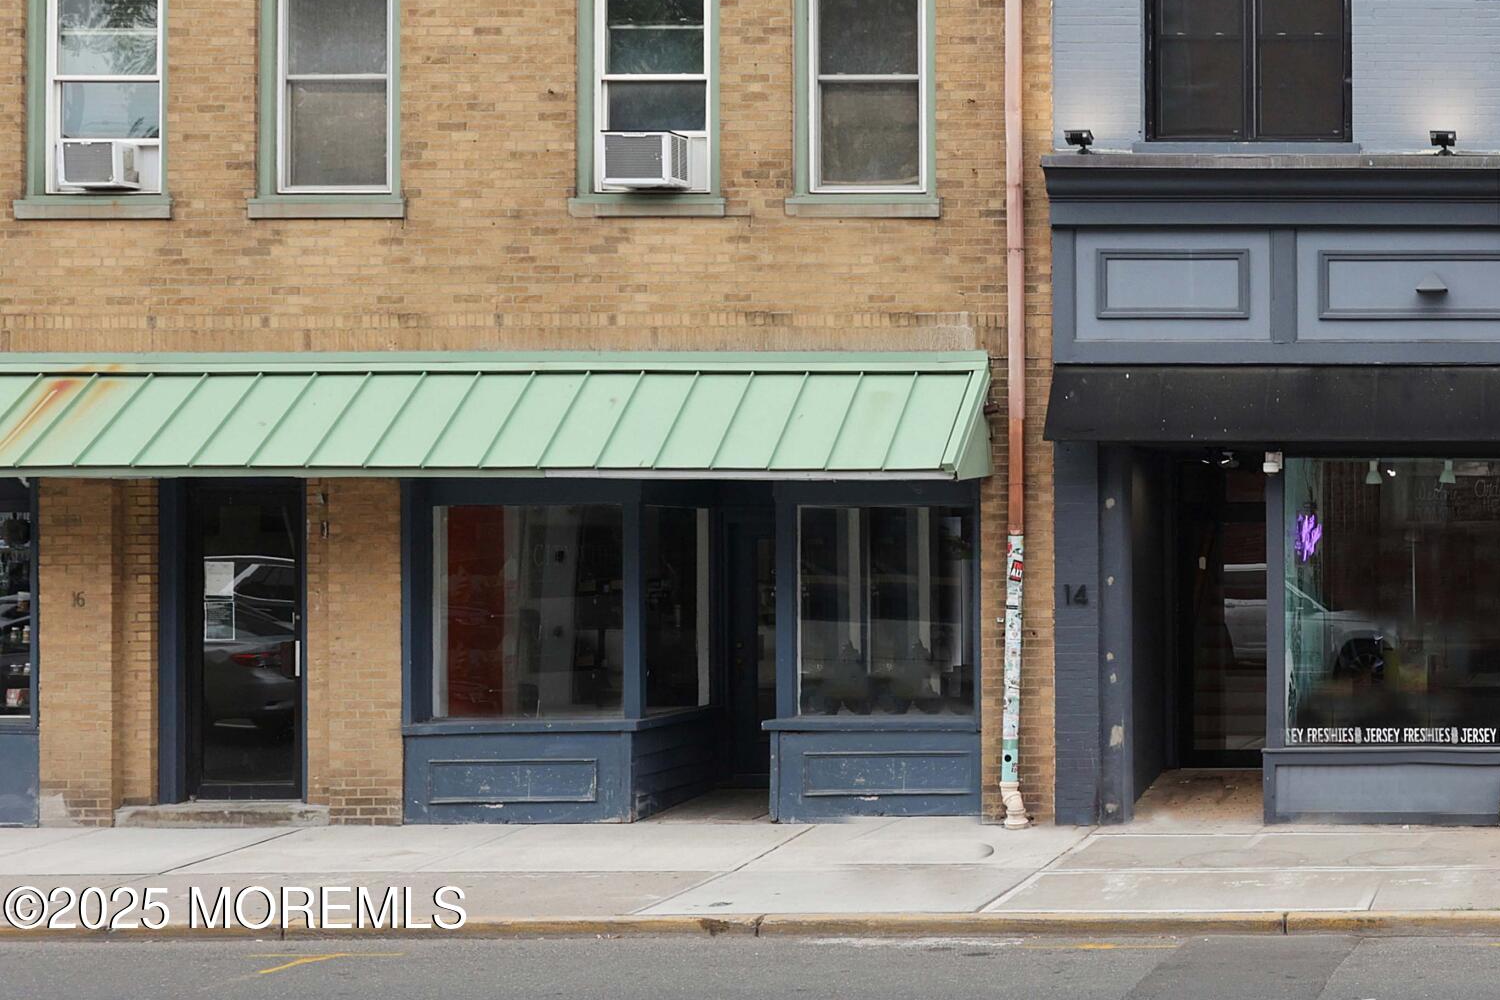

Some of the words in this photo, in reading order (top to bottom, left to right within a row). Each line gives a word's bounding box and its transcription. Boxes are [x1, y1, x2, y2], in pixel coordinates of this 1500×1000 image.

[71, 590, 86, 608] 16
[1063, 584, 1089, 606] 14
[1306, 728, 1354, 743] FRESHIES
[1363, 728, 1401, 743] JERSEY
[1403, 728, 1451, 743] FRESHIES
[1460, 728, 1497, 744] JERSEY
